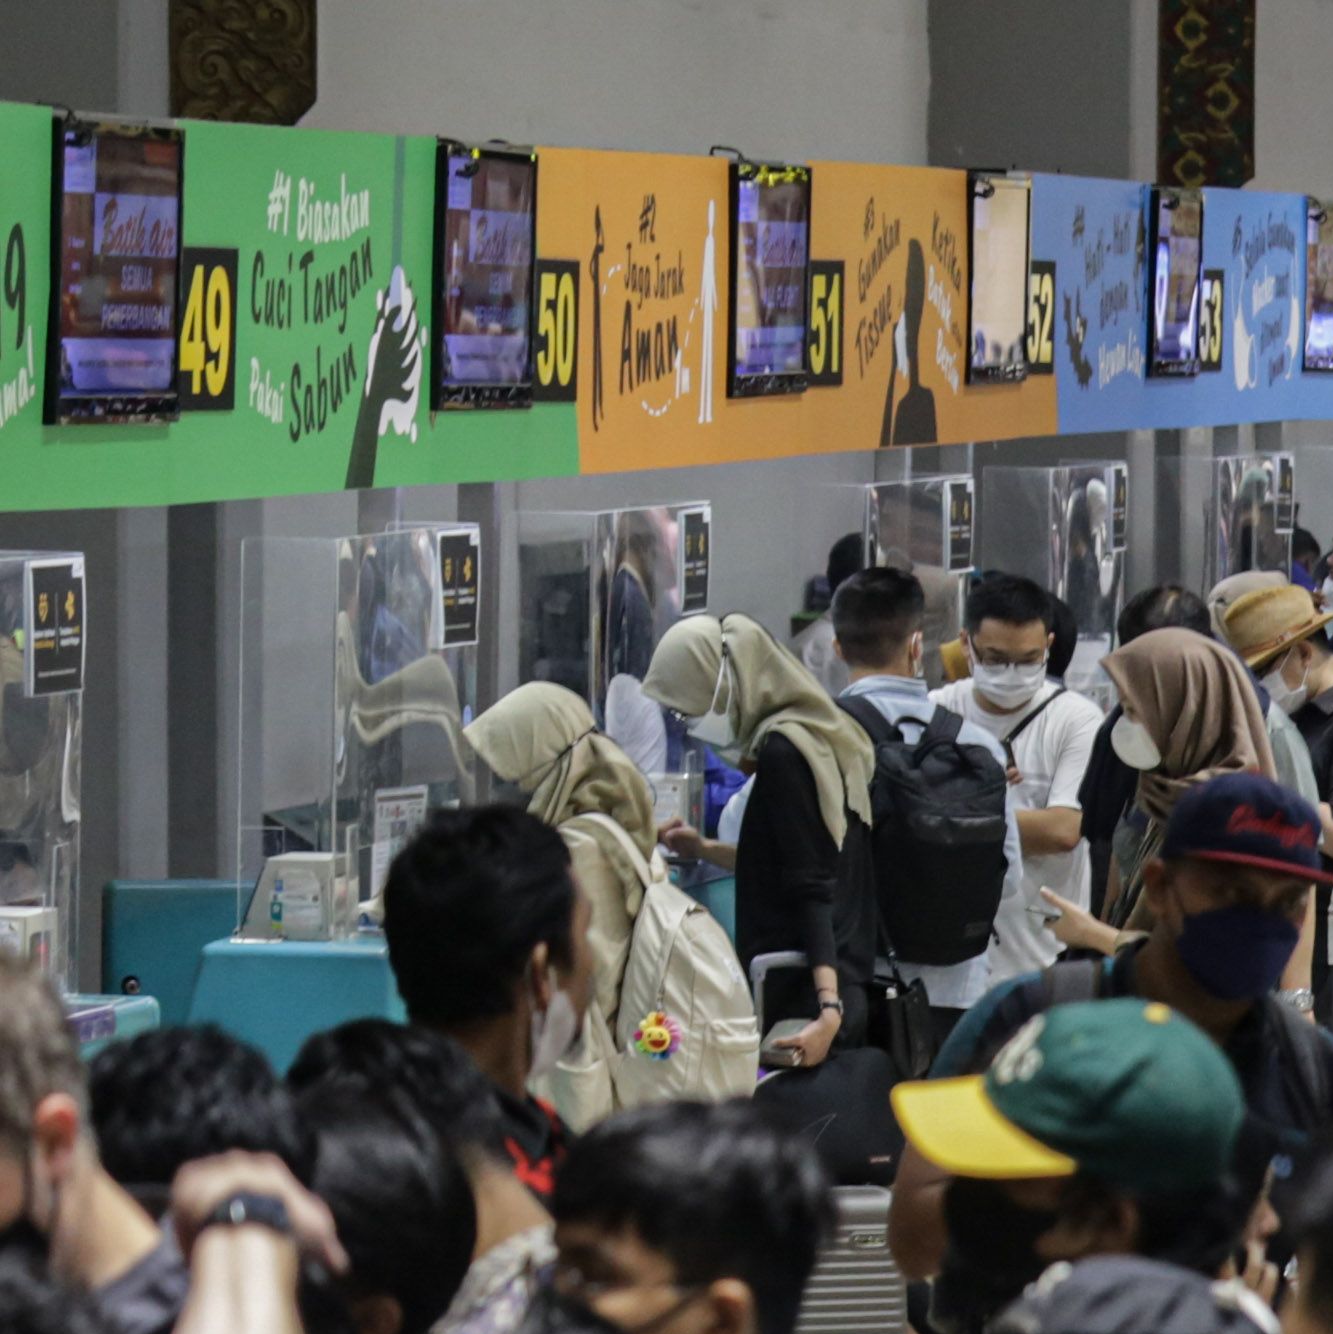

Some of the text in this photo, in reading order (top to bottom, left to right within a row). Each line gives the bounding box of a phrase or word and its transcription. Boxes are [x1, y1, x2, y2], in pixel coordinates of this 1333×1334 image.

[267, 169, 370, 244] #1 Biasakan
[639, 194, 656, 243] #2
[251, 237, 373, 334] Cuci Tangan
[623, 242, 685, 311] Jaga Jarak
[809, 272, 841, 375] 51
[1026, 272, 1054, 364] 52
[1199, 278, 1222, 364] 53
[0, 325, 36, 428] ma!
[179, 263, 231, 396] 49
[537, 271, 576, 387] 50
[618, 299, 680, 396] Aman
[855, 283, 893, 380] Tissue
[249, 343, 357, 443] Pakai Sabun
